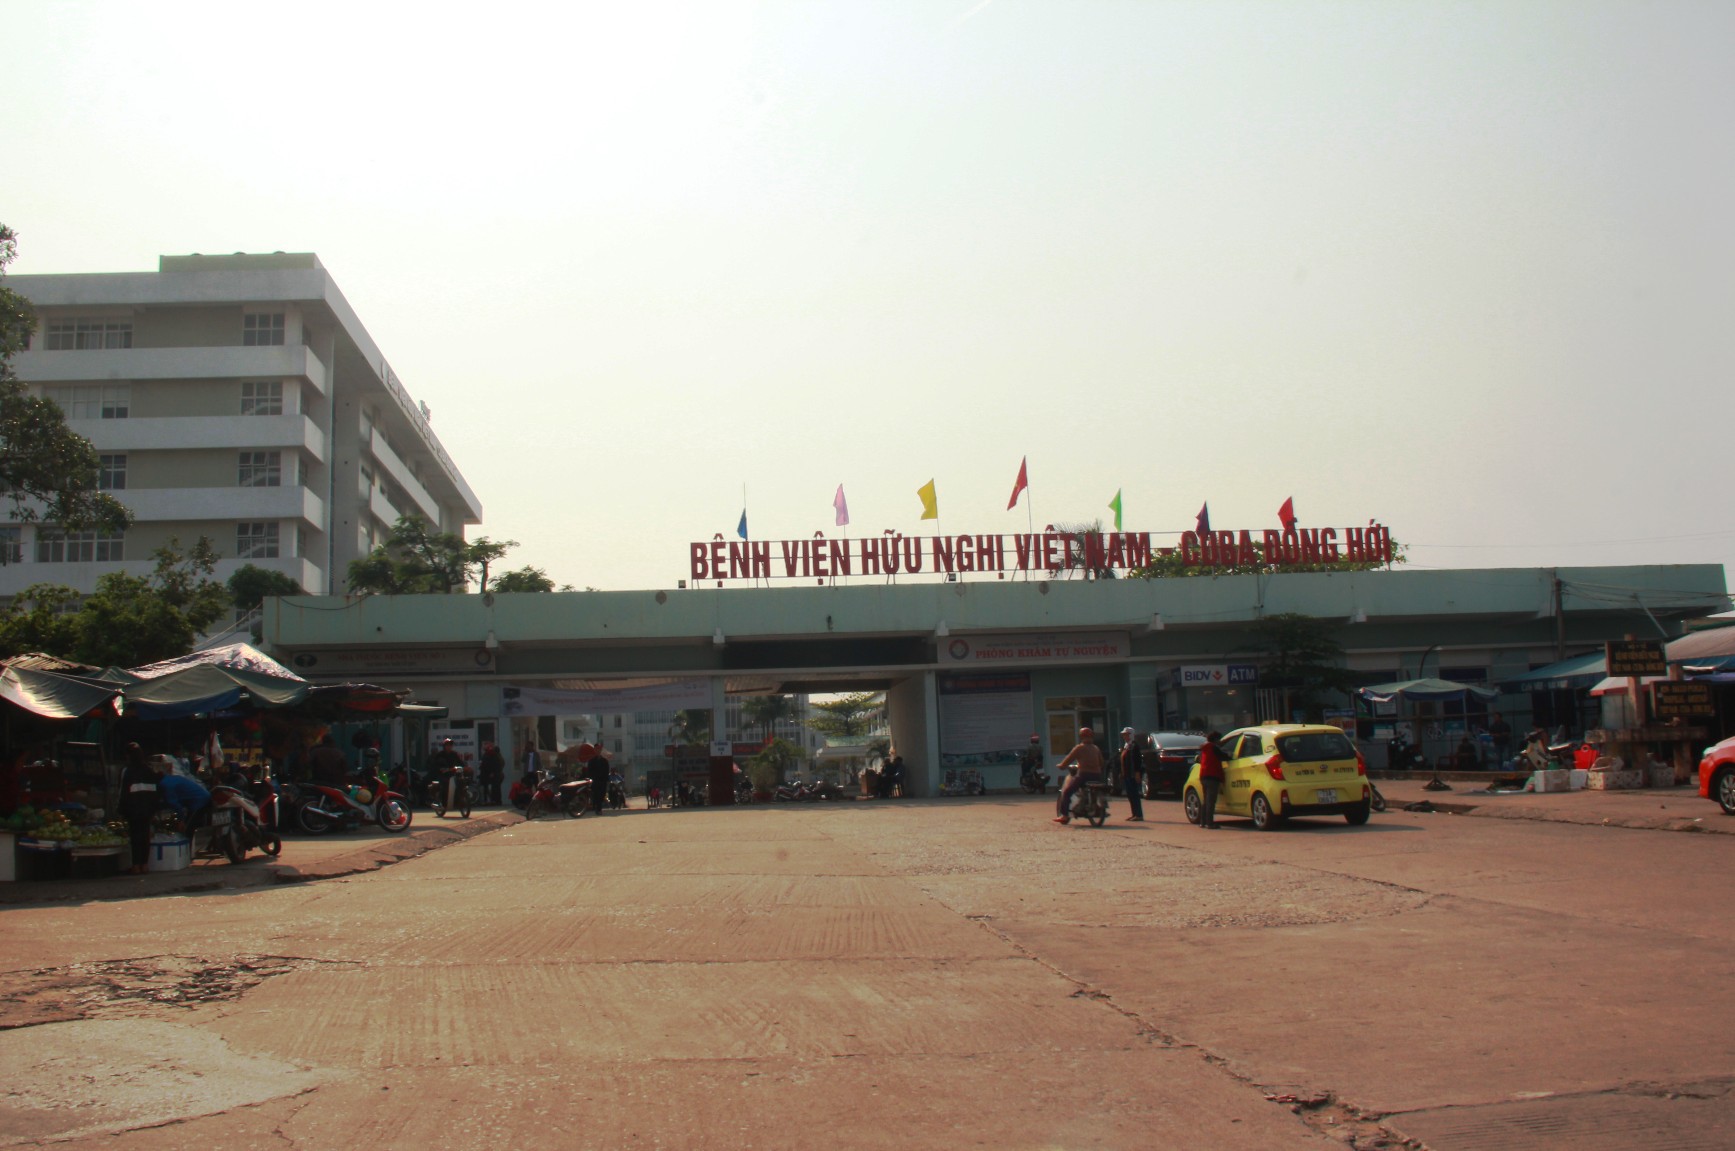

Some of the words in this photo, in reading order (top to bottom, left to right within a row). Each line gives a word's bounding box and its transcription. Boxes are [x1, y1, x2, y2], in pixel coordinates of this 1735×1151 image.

[690, 533, 770, 588] BỆNH
[781, 530, 850, 585] VIỆN
[860, 528, 923, 575] HỮU
[932, 534, 1005, 580] NGHỊ
[1084, 531, 1151, 570] NAM
[1181, 529, 1258, 567] CUBA
[1345, 518, 1392, 564] HỚI
[1184, 670, 1212, 681] BIDV
[1230, 669, 1256, 681] ATM
